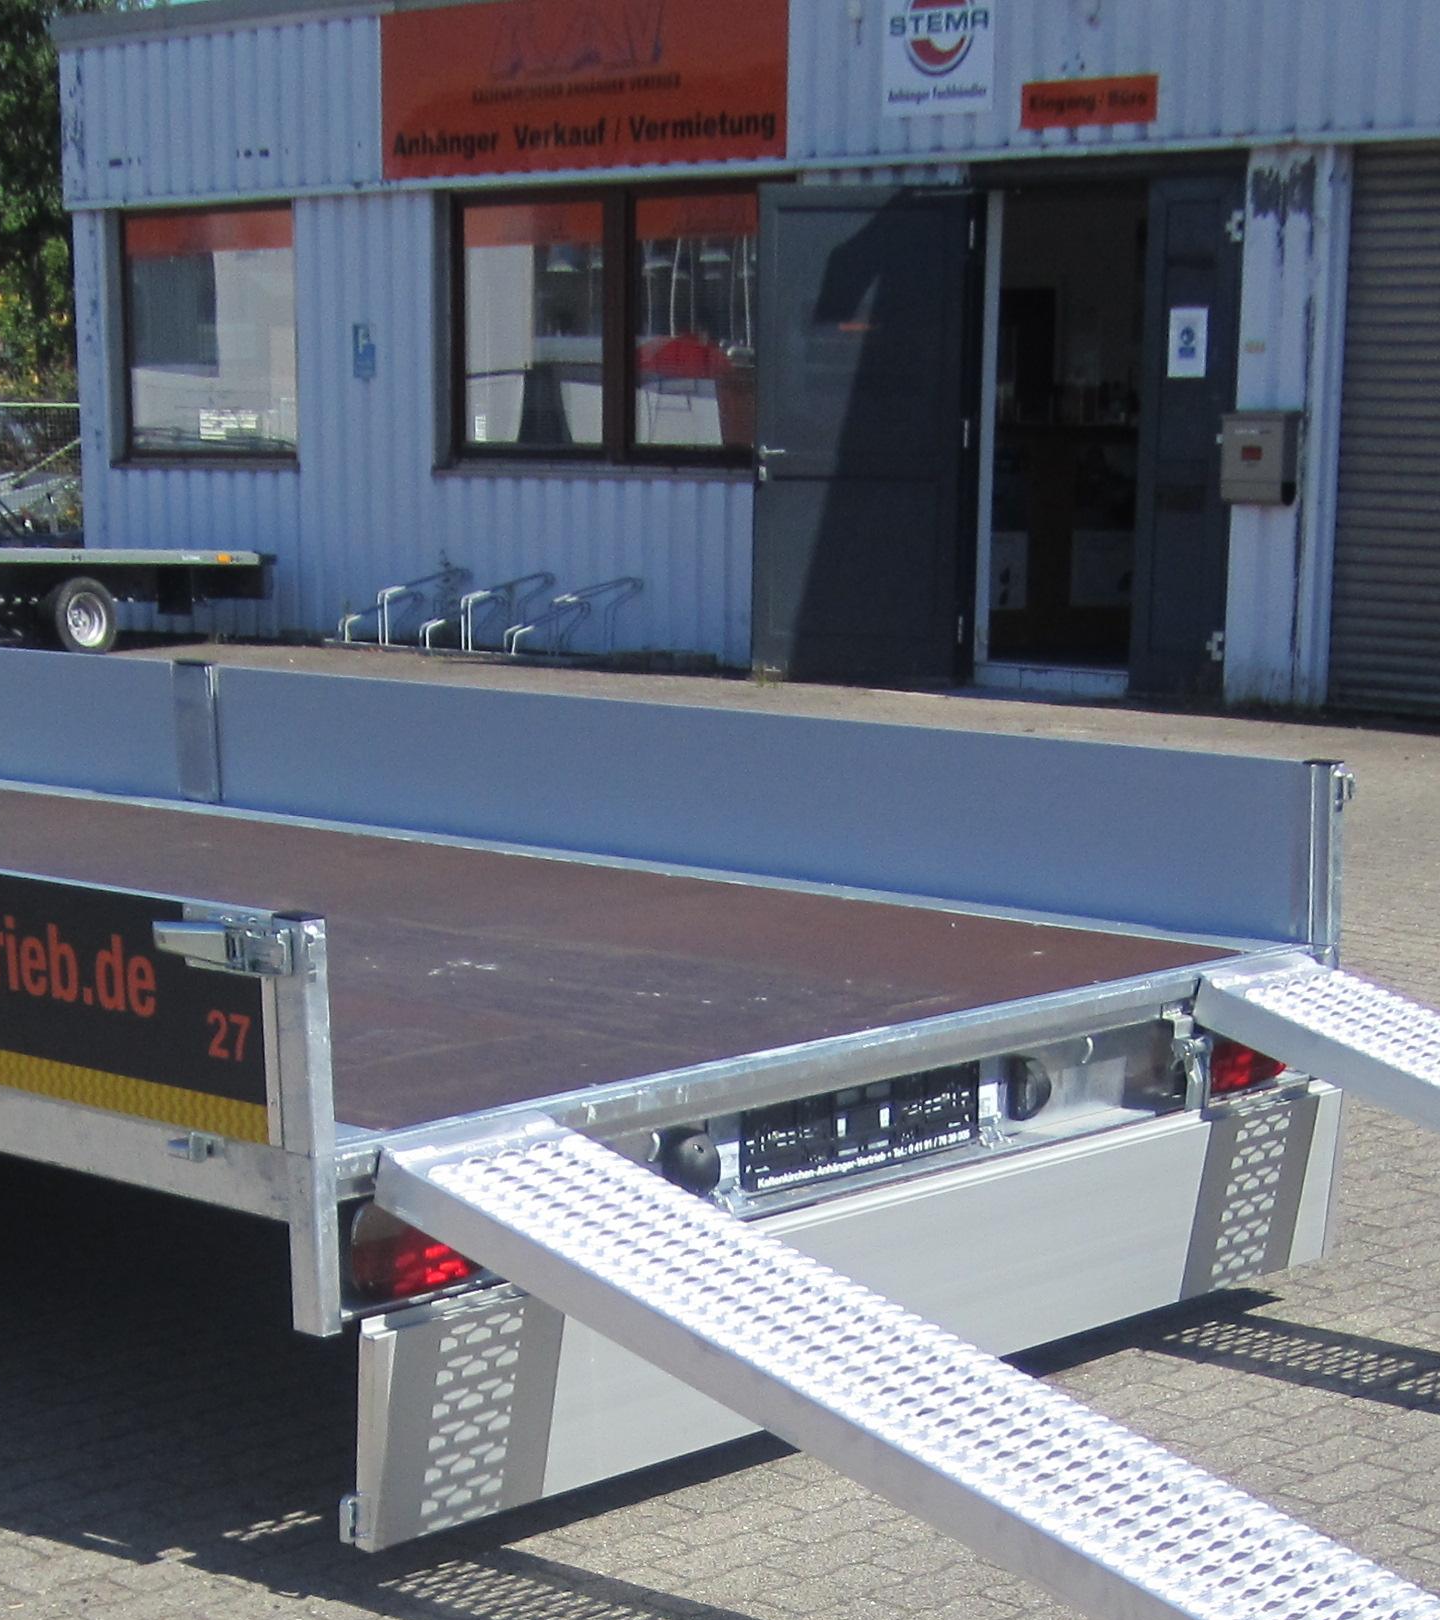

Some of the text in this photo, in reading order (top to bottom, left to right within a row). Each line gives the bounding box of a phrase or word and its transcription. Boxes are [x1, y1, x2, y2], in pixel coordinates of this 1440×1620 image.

[890, 9, 989, 36] STEMA
[394, 129, 499, 160] Anhänger
[513, 117, 607, 150] Verkauf
[629, 110, 776, 143] Vermietung
[207, 1009, 251, 1061] 27
